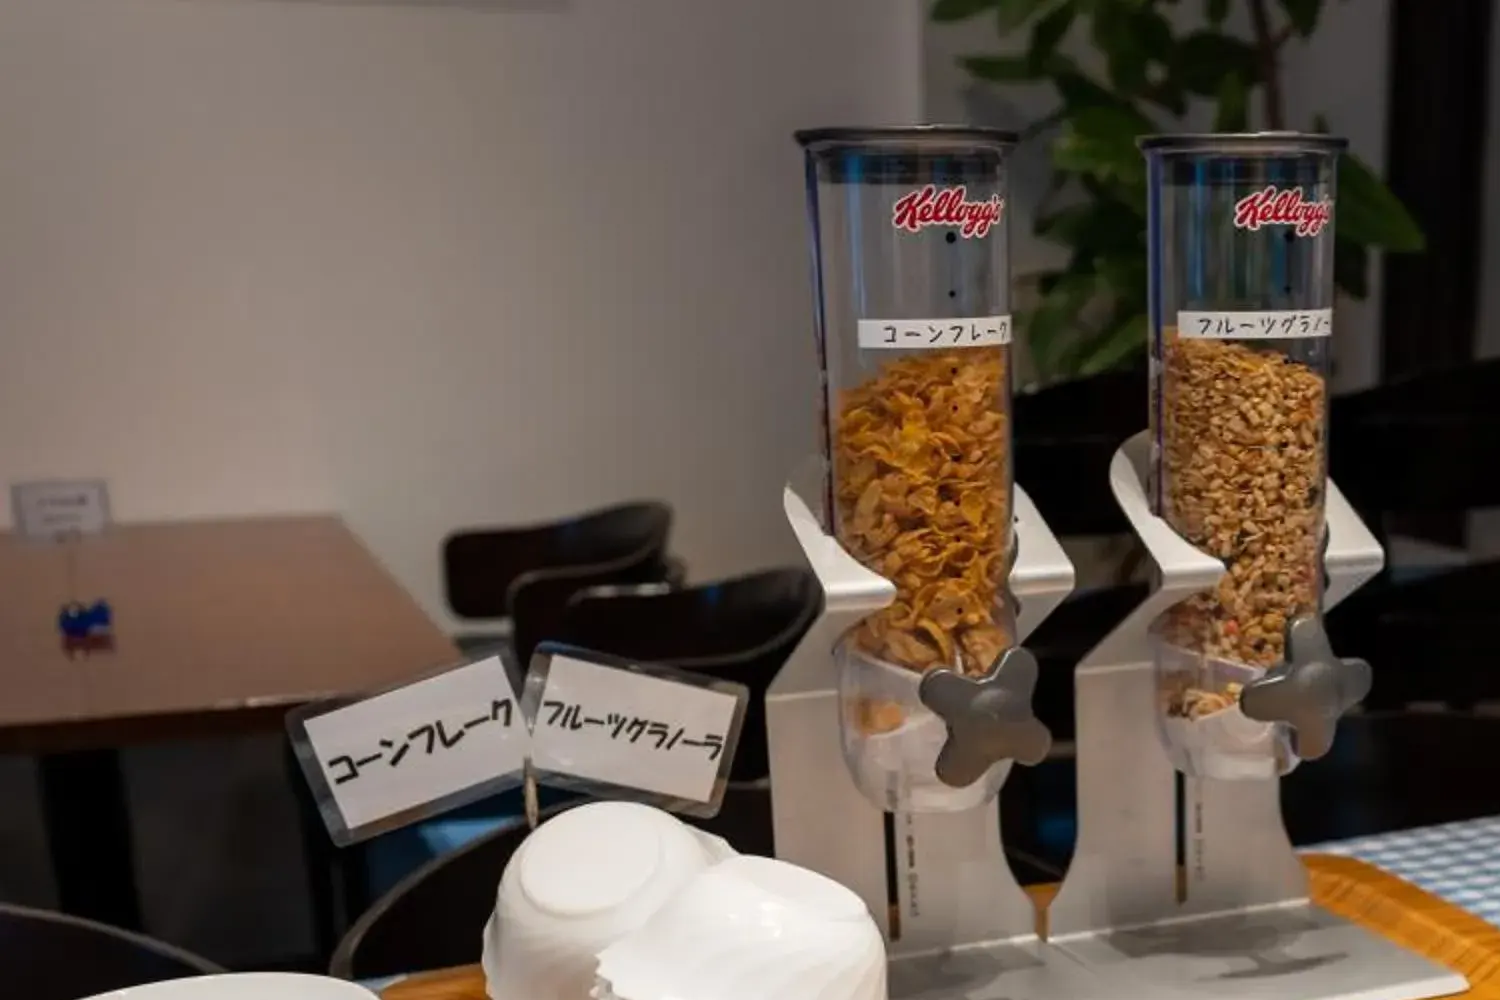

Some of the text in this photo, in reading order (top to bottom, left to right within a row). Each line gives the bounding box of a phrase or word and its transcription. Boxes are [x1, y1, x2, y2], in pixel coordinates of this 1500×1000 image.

[328, 699, 513, 784] コーンフレーク
[543, 700, 723, 761] フルーツグラノーラ
